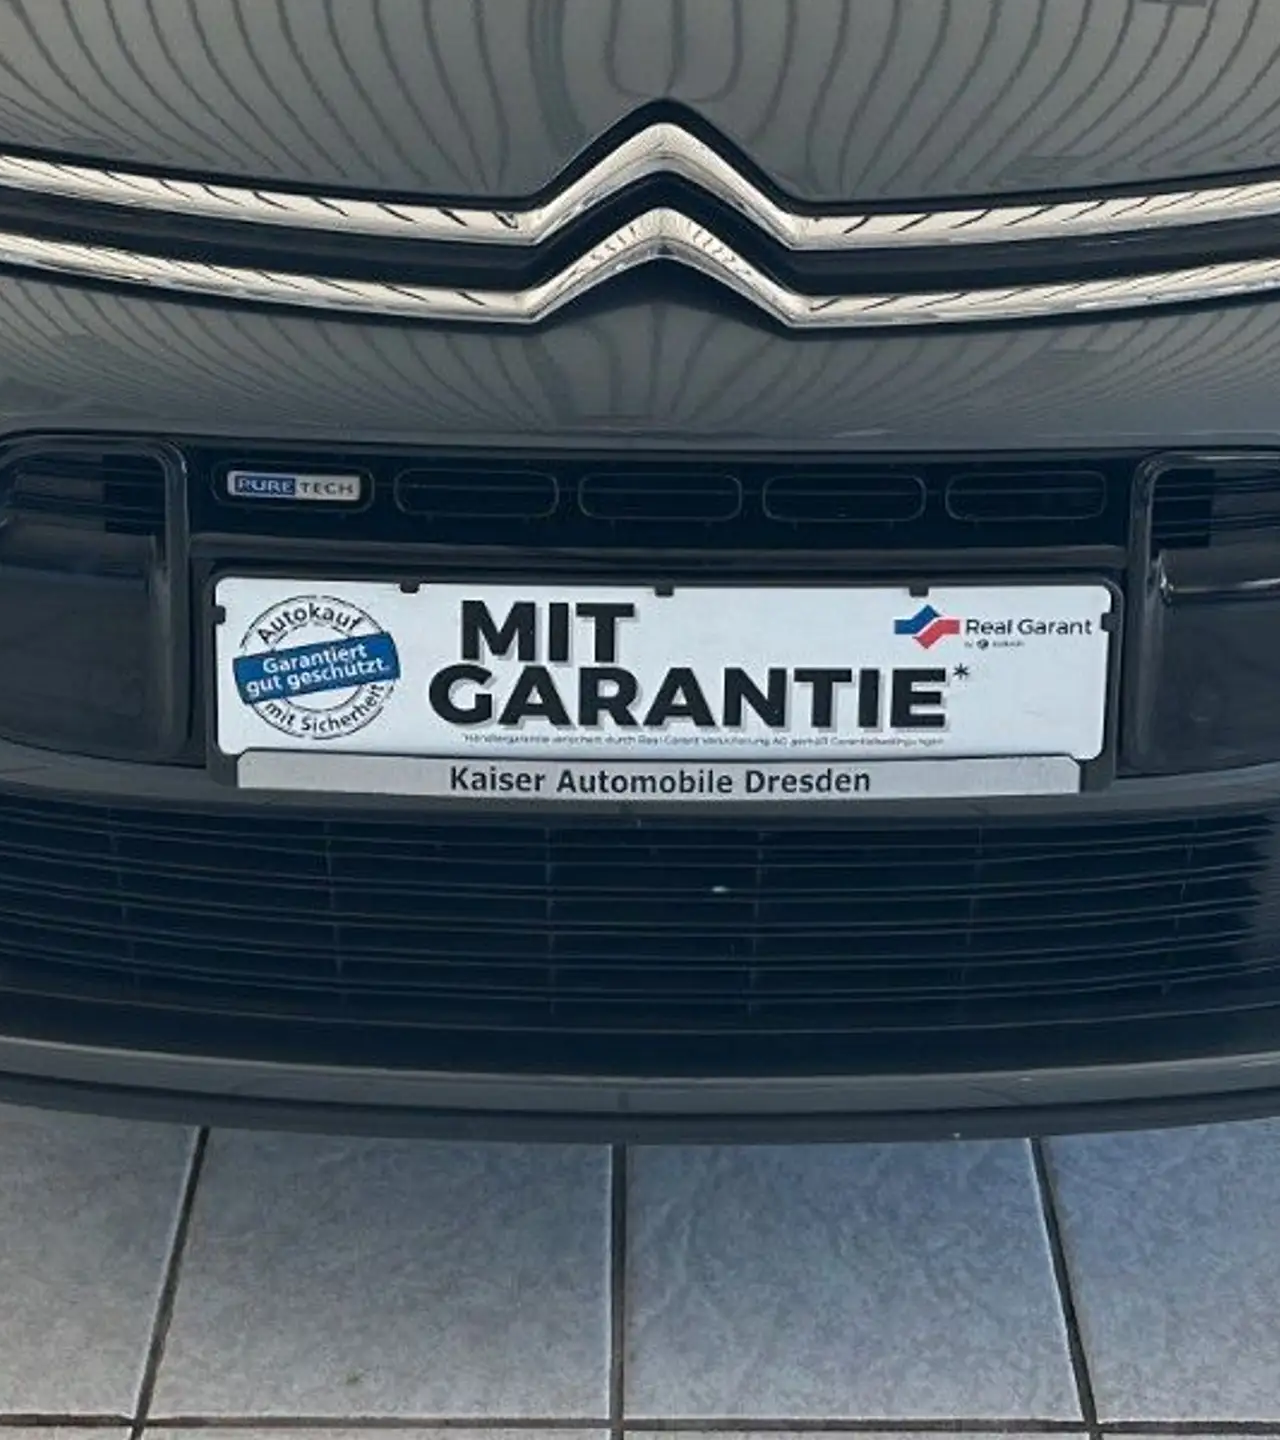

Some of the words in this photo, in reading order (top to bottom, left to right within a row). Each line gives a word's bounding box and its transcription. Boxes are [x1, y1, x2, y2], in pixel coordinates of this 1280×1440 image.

[257, 602, 366, 645] Autokauf
[460, 599, 636, 664] MIT
[966, 619, 1012, 636] Real
[1017, 619, 1093, 636] Garant
[262, 643, 368, 674] Garantiert
[246, 675, 284, 698] gut
[264, 702, 295, 726] mit
[301, 684, 385, 733] Sicherheit
[449, 766, 545, 792] Kaiser
[556, 768, 733, 794] Automobile
[744, 769, 870, 794] Dresden
